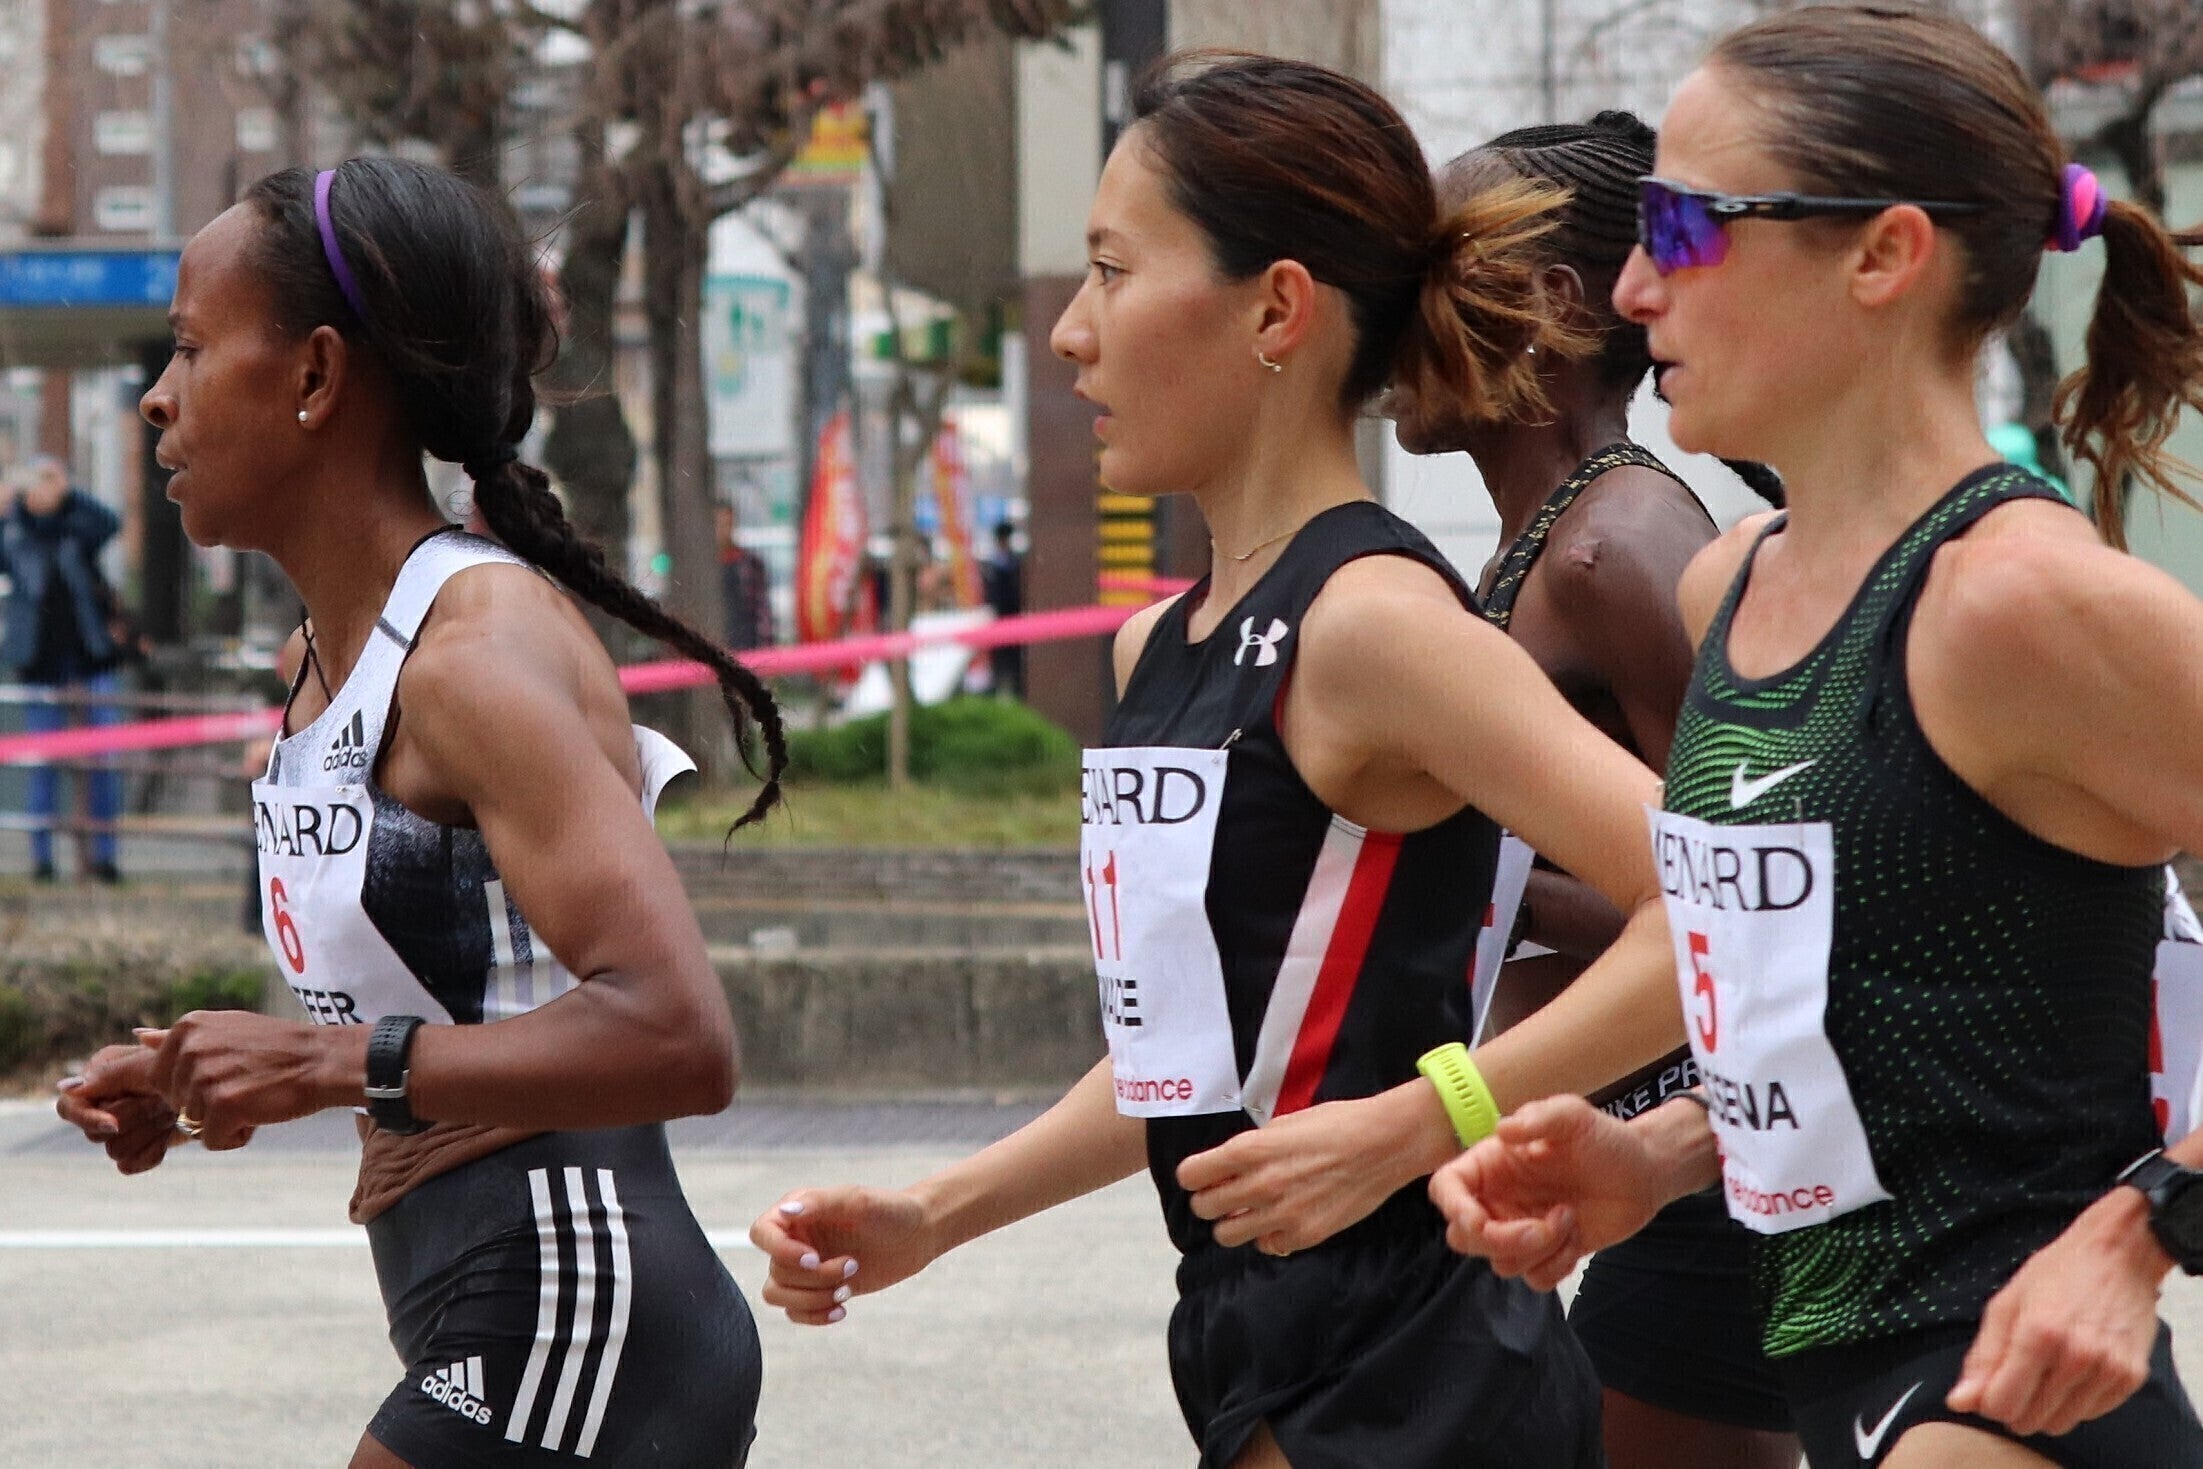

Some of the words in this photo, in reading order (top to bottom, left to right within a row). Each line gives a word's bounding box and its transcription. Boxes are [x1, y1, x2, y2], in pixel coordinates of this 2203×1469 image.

[1087, 850, 1121, 961] 11
[1656, 826, 1813, 911] ENARD
[270, 876, 305, 974] 6
[292, 986, 364, 1025] FER
[1688, 931, 1716, 1054] 5
[1703, 1070, 1800, 1130] SENA
[421, 1375, 493, 1425] adidas
